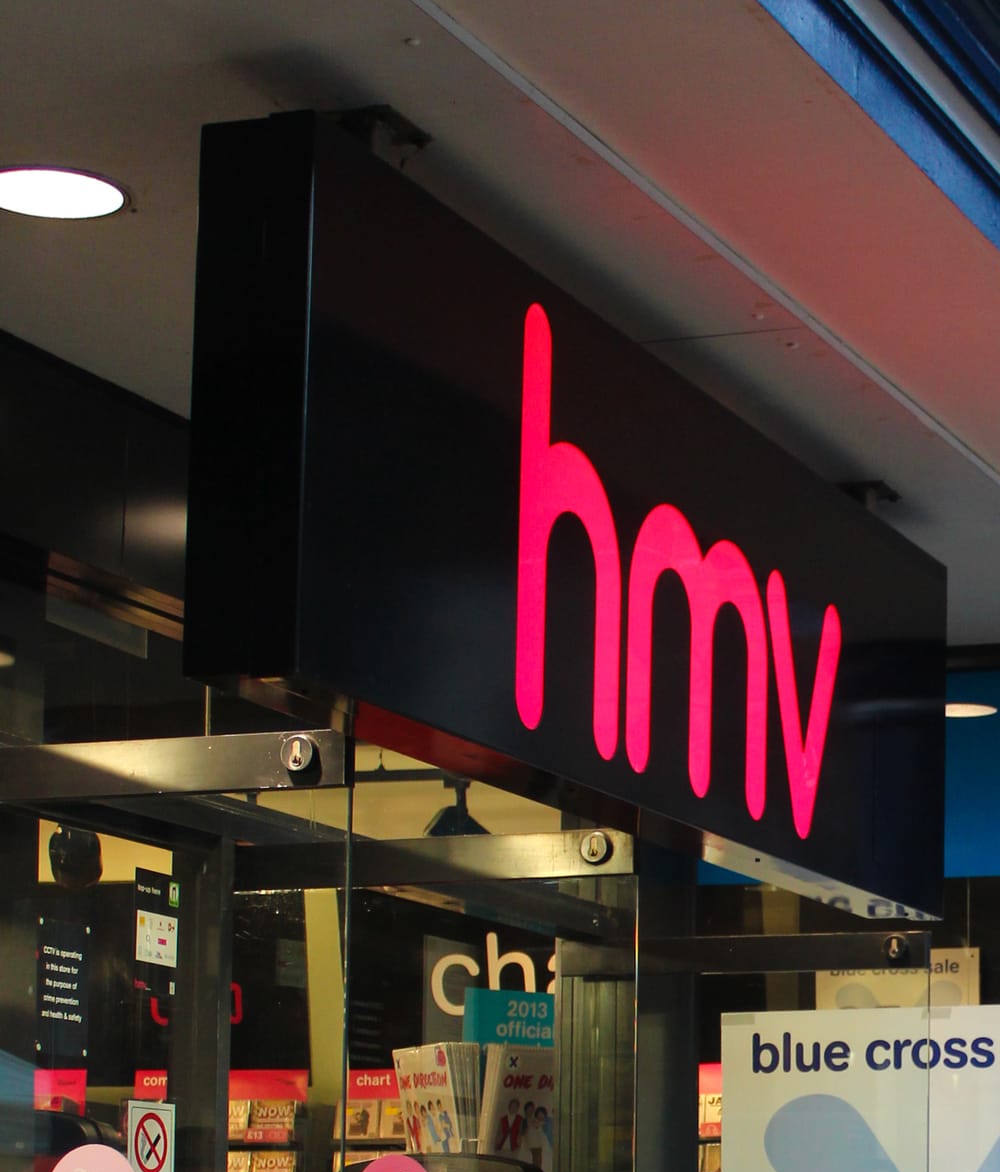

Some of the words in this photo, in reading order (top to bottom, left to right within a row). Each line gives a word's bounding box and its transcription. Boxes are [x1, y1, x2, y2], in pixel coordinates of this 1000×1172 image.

[515, 302, 842, 840] hmv
[507, 1000, 547, 1018] 2013
[752, 1032, 851, 1074] blue
[865, 1036, 995, 1071] cross
[356, 1073, 391, 1086] chart
[503, 1074, 534, 1090] ONE
[258, 1105, 291, 1118] NOW
[247, 1130, 263, 1140] £13
[257, 1156, 290, 1168] NOW
